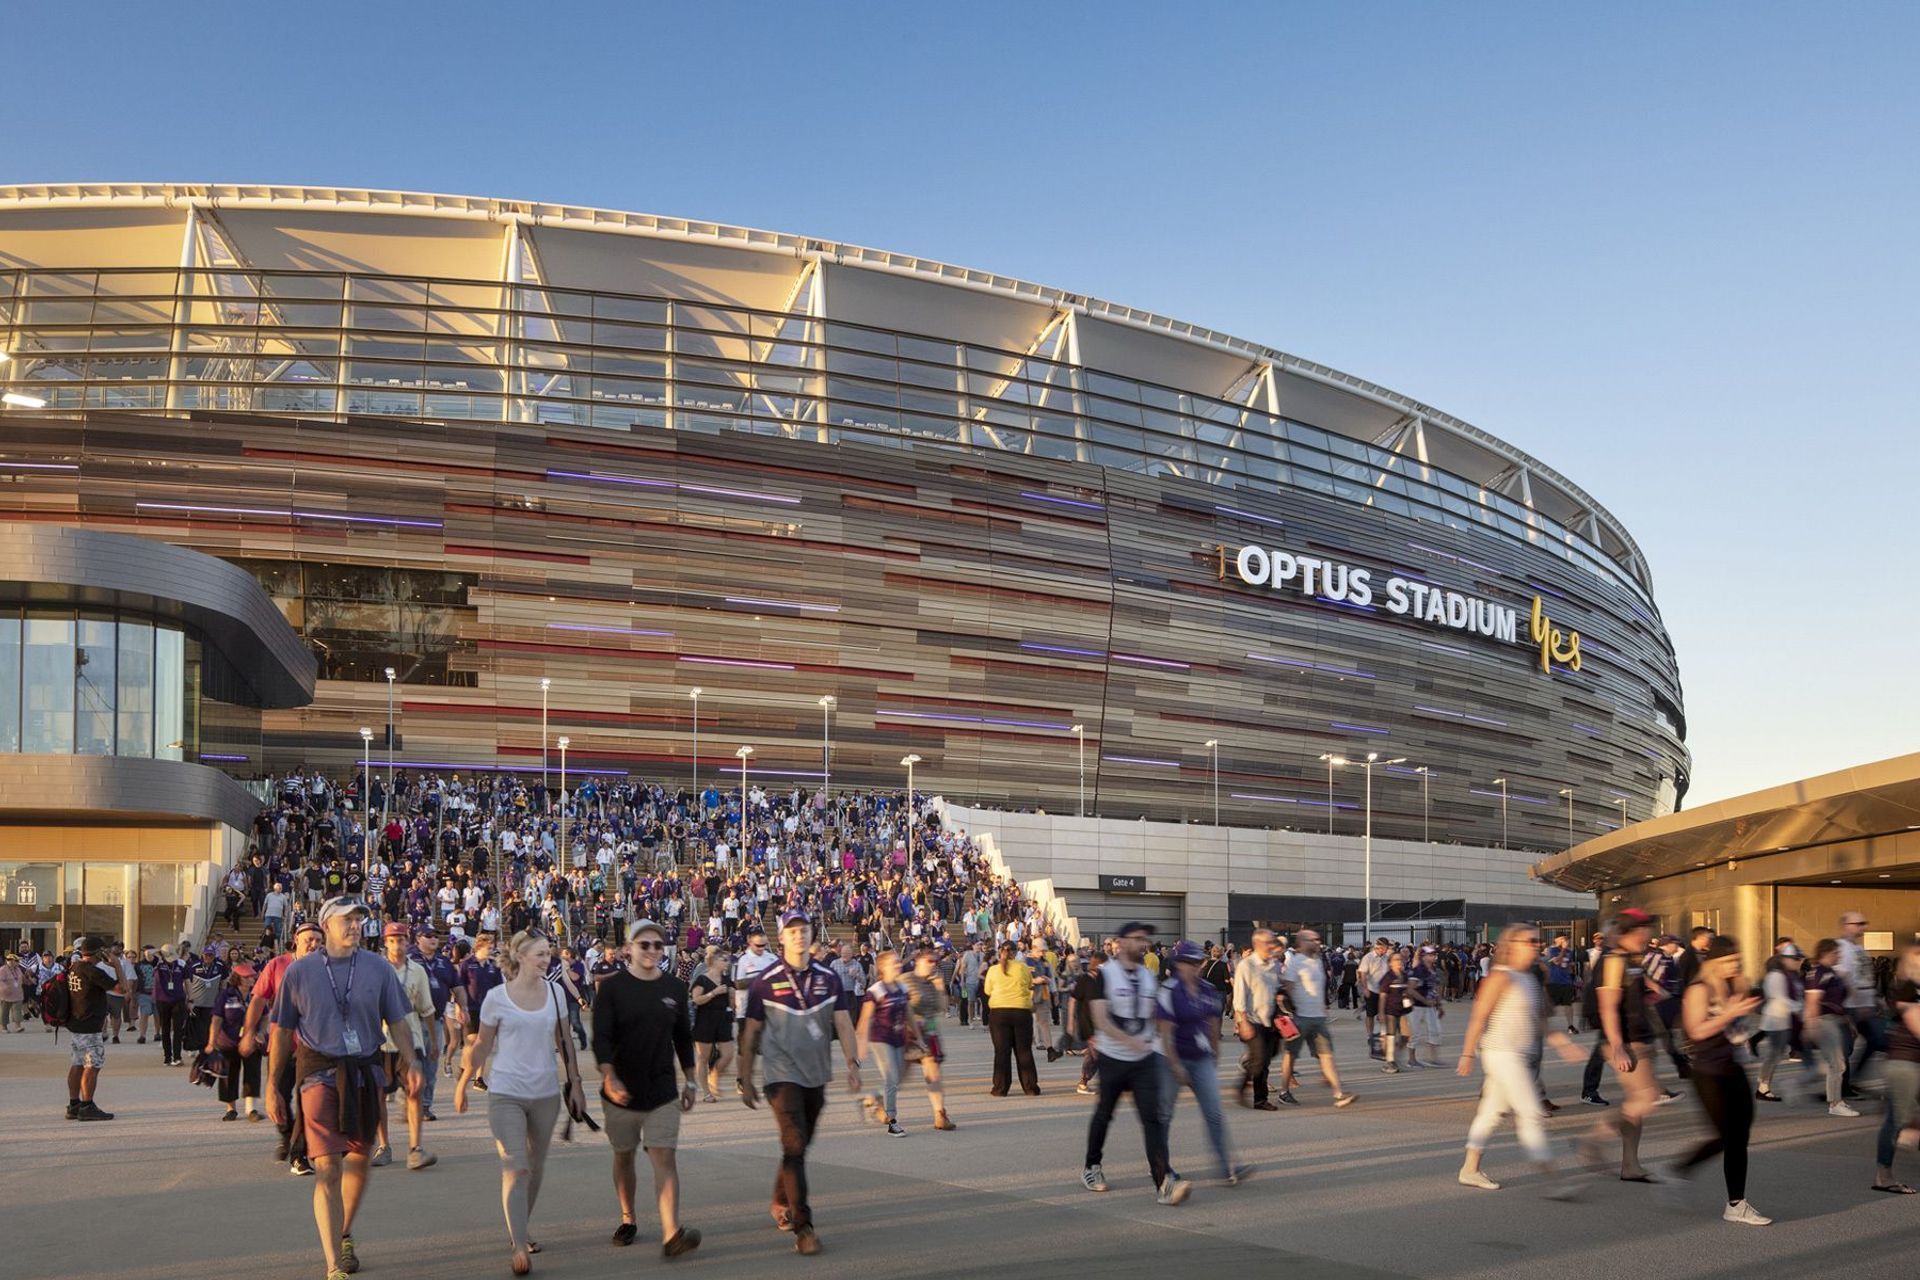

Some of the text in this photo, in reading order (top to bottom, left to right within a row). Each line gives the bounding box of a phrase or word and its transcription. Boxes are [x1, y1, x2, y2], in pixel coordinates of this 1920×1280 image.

[1237, 545, 1517, 643] OPTUS STADIUM
[1112, 878, 1128, 886] Gate
